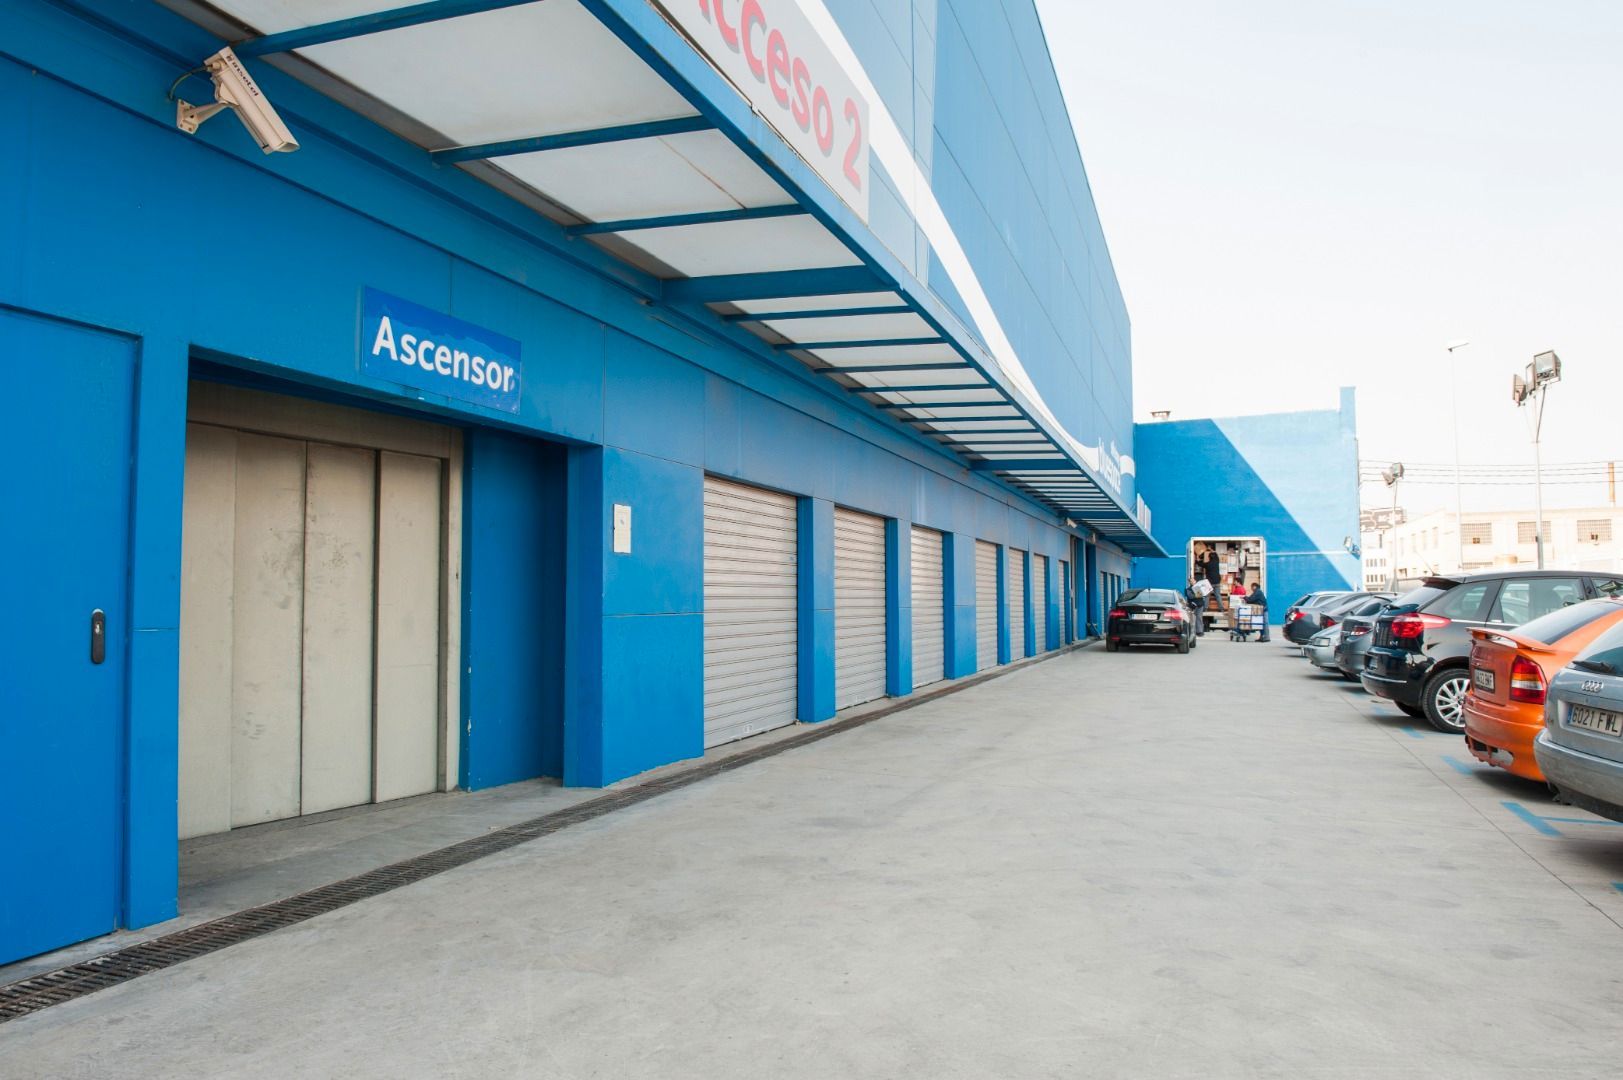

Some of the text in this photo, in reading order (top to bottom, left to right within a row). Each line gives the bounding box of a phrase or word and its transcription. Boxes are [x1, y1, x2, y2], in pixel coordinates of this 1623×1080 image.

[699, 0, 861, 191] cceso 2
[371, 315, 514, 392] Ascensor
[1572, 706, 1595, 727] 6021
